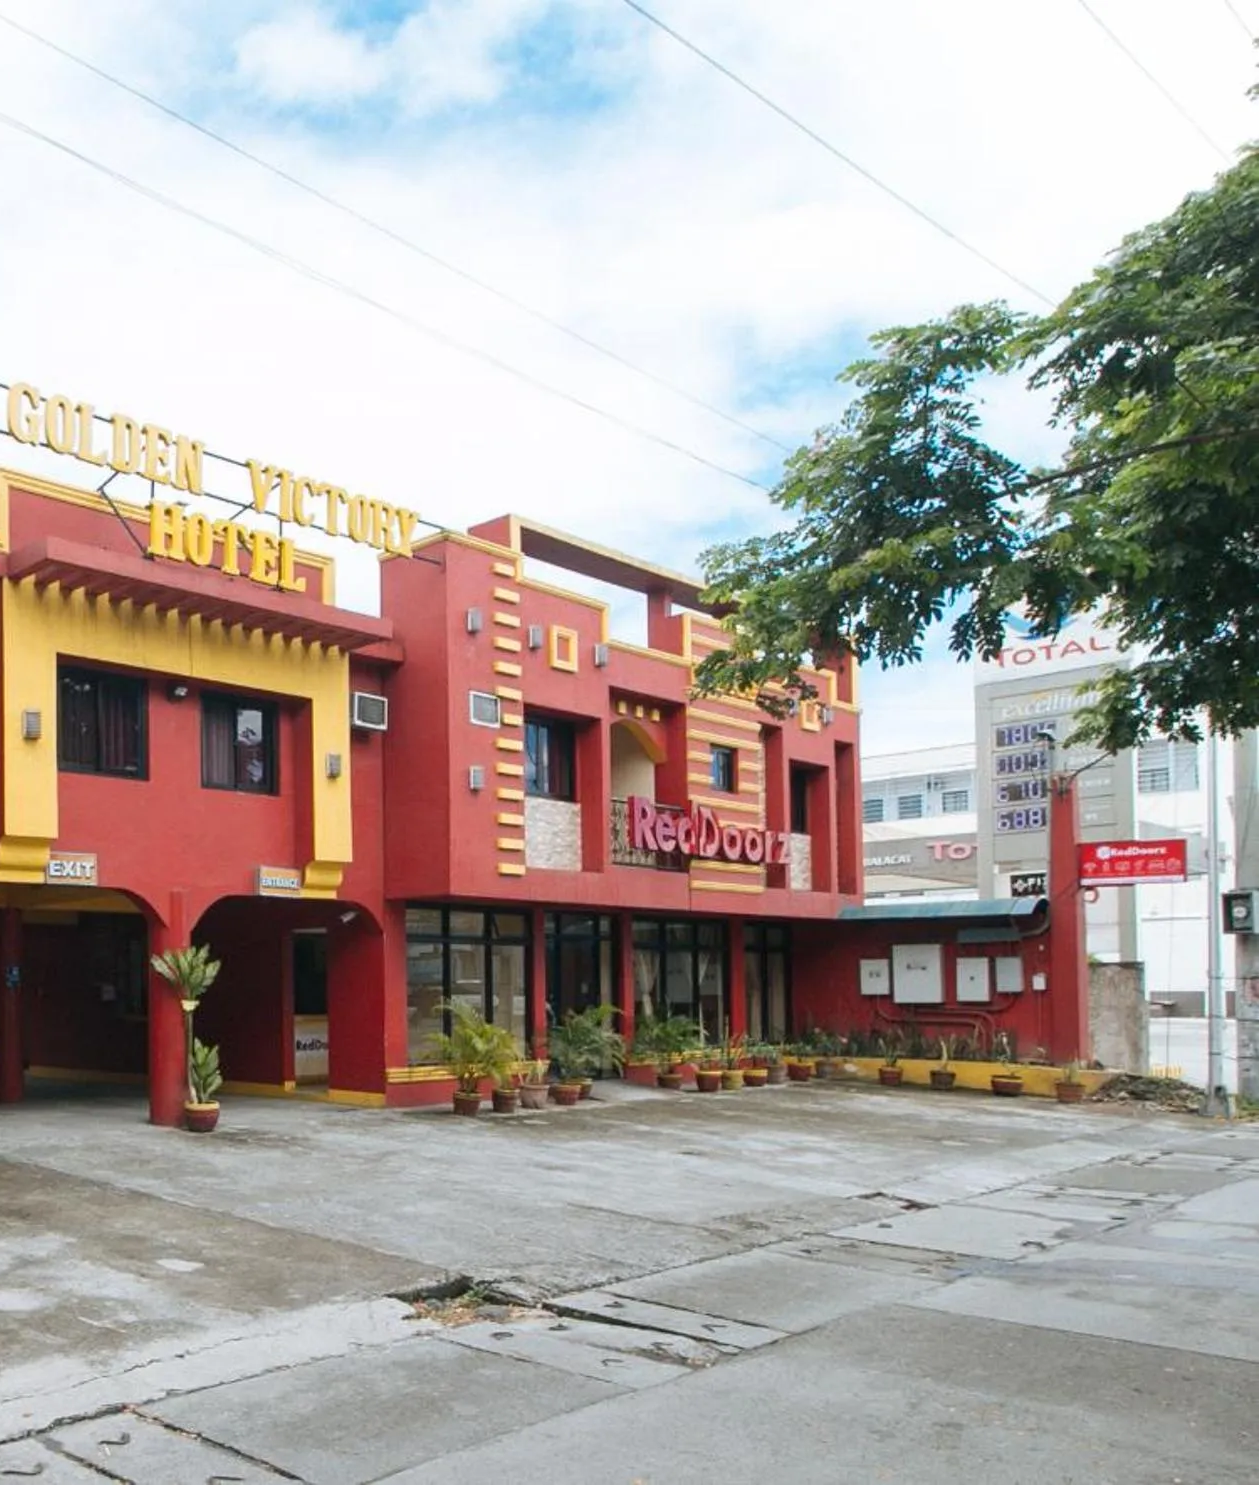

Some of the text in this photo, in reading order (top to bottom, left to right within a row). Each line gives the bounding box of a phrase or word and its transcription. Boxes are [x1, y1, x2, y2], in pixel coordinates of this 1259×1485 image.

[6, 382, 420, 558] GOLDEN VICTORY
[148, 499, 306, 592] HOTEL
[994, 637, 1110, 668] TOTAL
[628, 796, 792, 864] RedDoorz
[49, 860, 94, 877] EXIT
